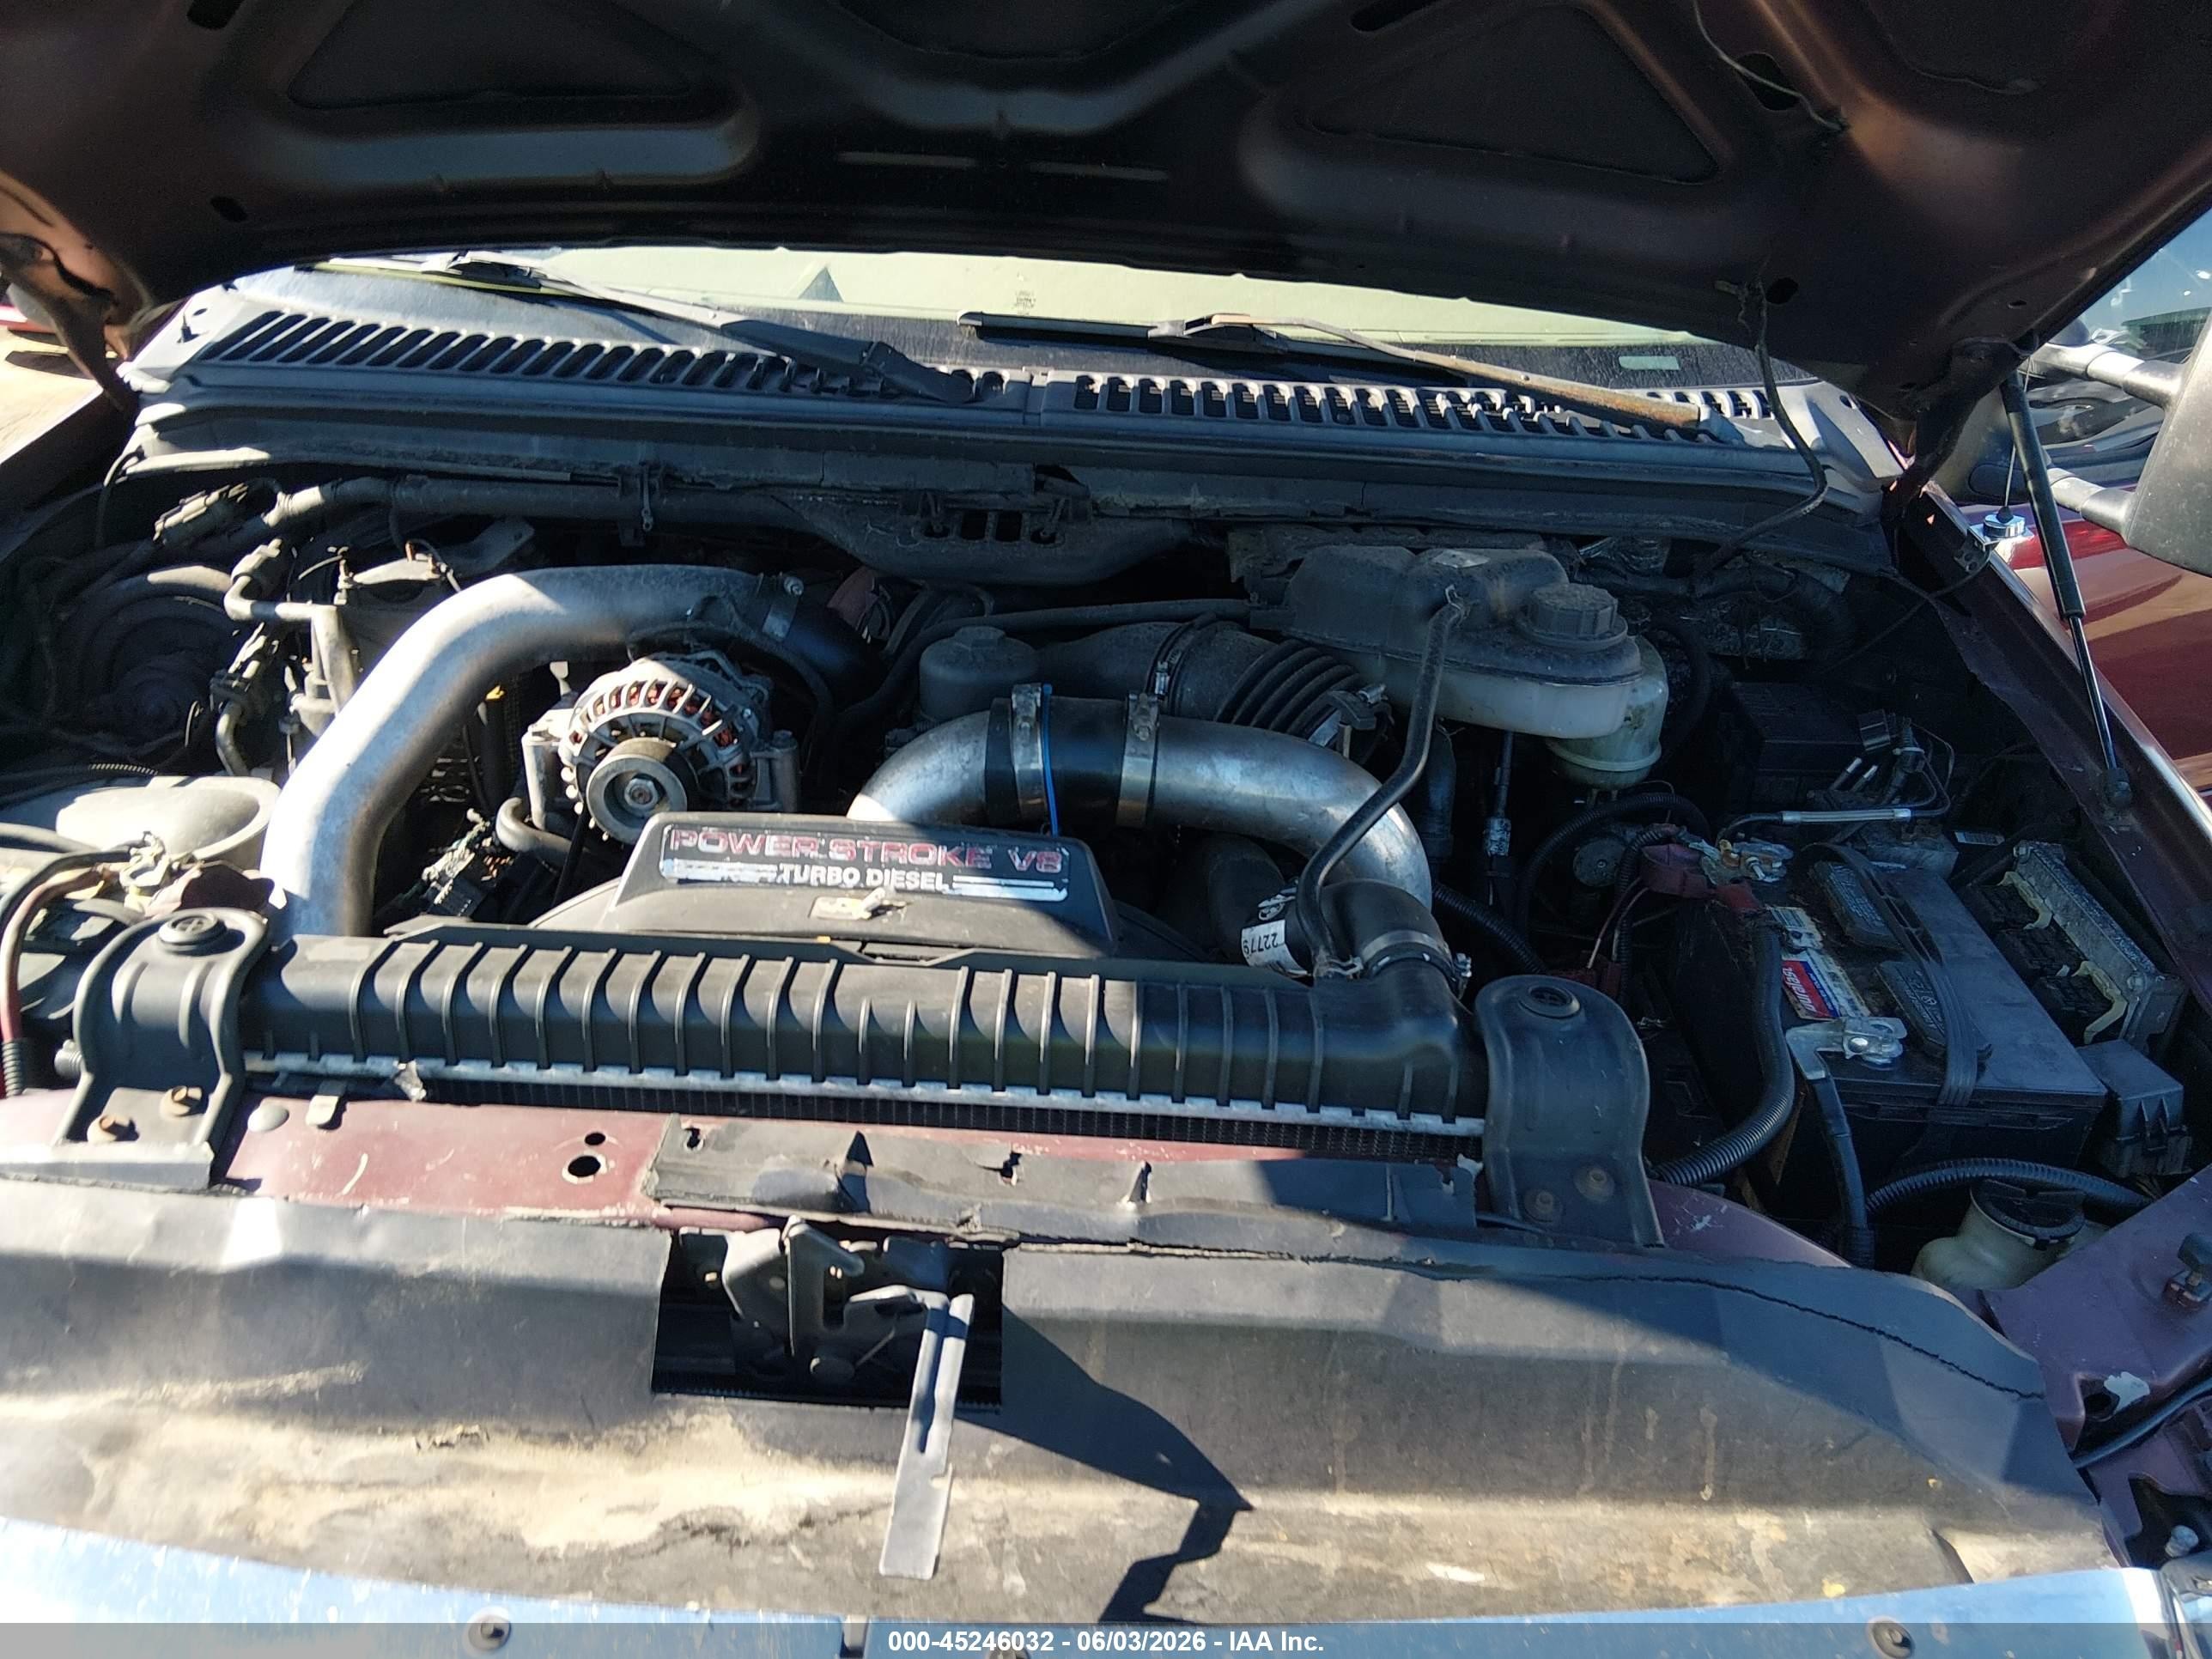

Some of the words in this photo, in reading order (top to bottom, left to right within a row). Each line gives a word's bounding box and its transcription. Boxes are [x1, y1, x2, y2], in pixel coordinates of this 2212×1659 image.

[670, 828, 819, 858] POWER
[829, 838, 994, 868] STROKE
[1008, 847, 1062, 872] V8
[779, 863, 860, 887] TURBO
[866, 868, 948, 893] DIESEL
